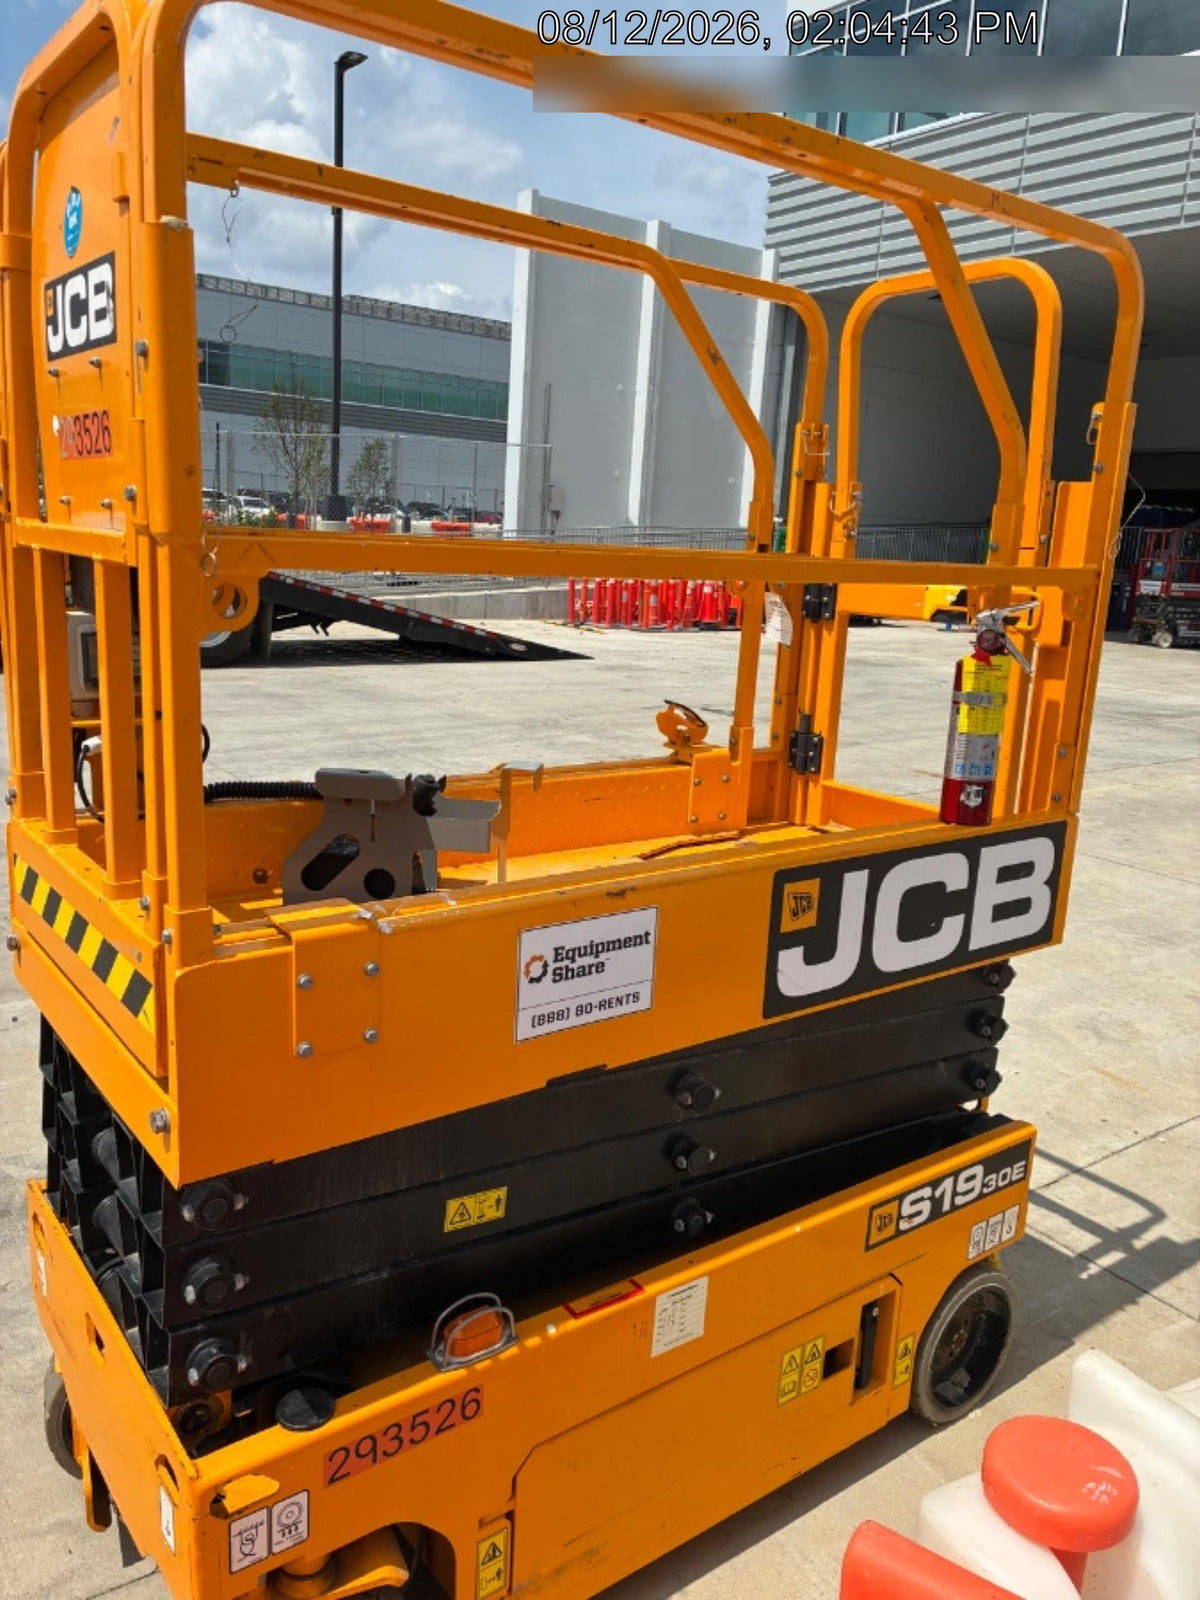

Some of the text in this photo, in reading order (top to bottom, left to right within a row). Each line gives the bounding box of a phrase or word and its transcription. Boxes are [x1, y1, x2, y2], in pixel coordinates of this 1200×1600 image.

[47, 263, 115, 353] JCB
[553, 930, 651, 964] Equipment
[777, 837, 1055, 996] JCB
[552, 961, 606, 983] Share
[531, 992, 640, 1028] (888) 80-RENTS
[327, 1387, 481, 1485] 293526
